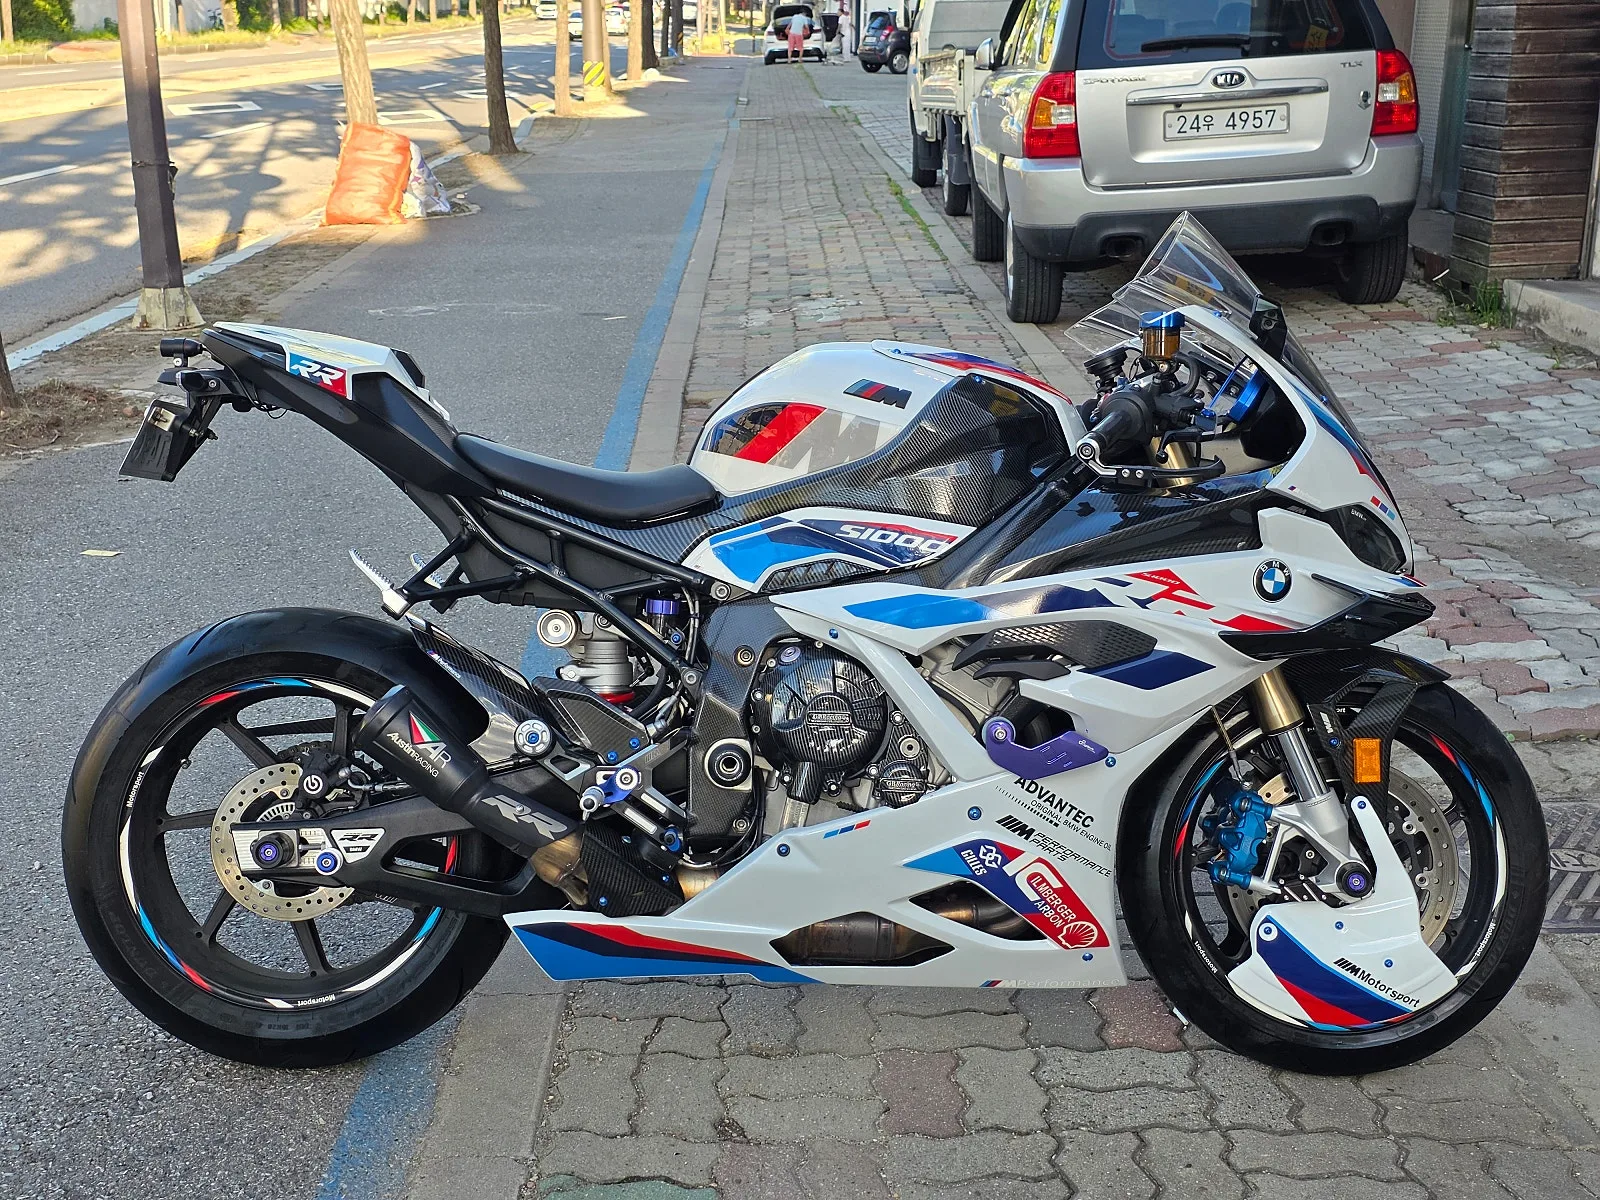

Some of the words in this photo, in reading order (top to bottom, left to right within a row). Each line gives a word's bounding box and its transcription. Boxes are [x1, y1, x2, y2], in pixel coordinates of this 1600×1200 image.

[1216, 74, 1240, 85] KIA
[1176, 114, 1215, 134] 24우
[1225, 109, 1277, 131] 4957
[290, 359, 345, 386] RR
[415, 741, 452, 769] AR
[126, 771, 145, 808] Motorsport
[1013, 777, 1095, 828] ADVANTEC
[481, 794, 568, 841] RR
[1030, 799, 1063, 823] ORIGINAL
[1062, 819, 1081, 833] BMW
[1079, 828, 1105, 848] ENGINE
[960, 849, 988, 876] GILLES
[1029, 838, 1070, 862] PARTS
[1034, 832, 1113, 878] PERFORMANCE
[1030, 875, 1077, 923] ILMBERGER
[1475, 921, 1497, 957] Motorsport
[1194, 940, 1218, 974] Motorsport
[297, 993, 336, 1007] Motorsport
[1017, 978, 1120, 988] Performance
[1357, 969, 1420, 1008] Motorsport
